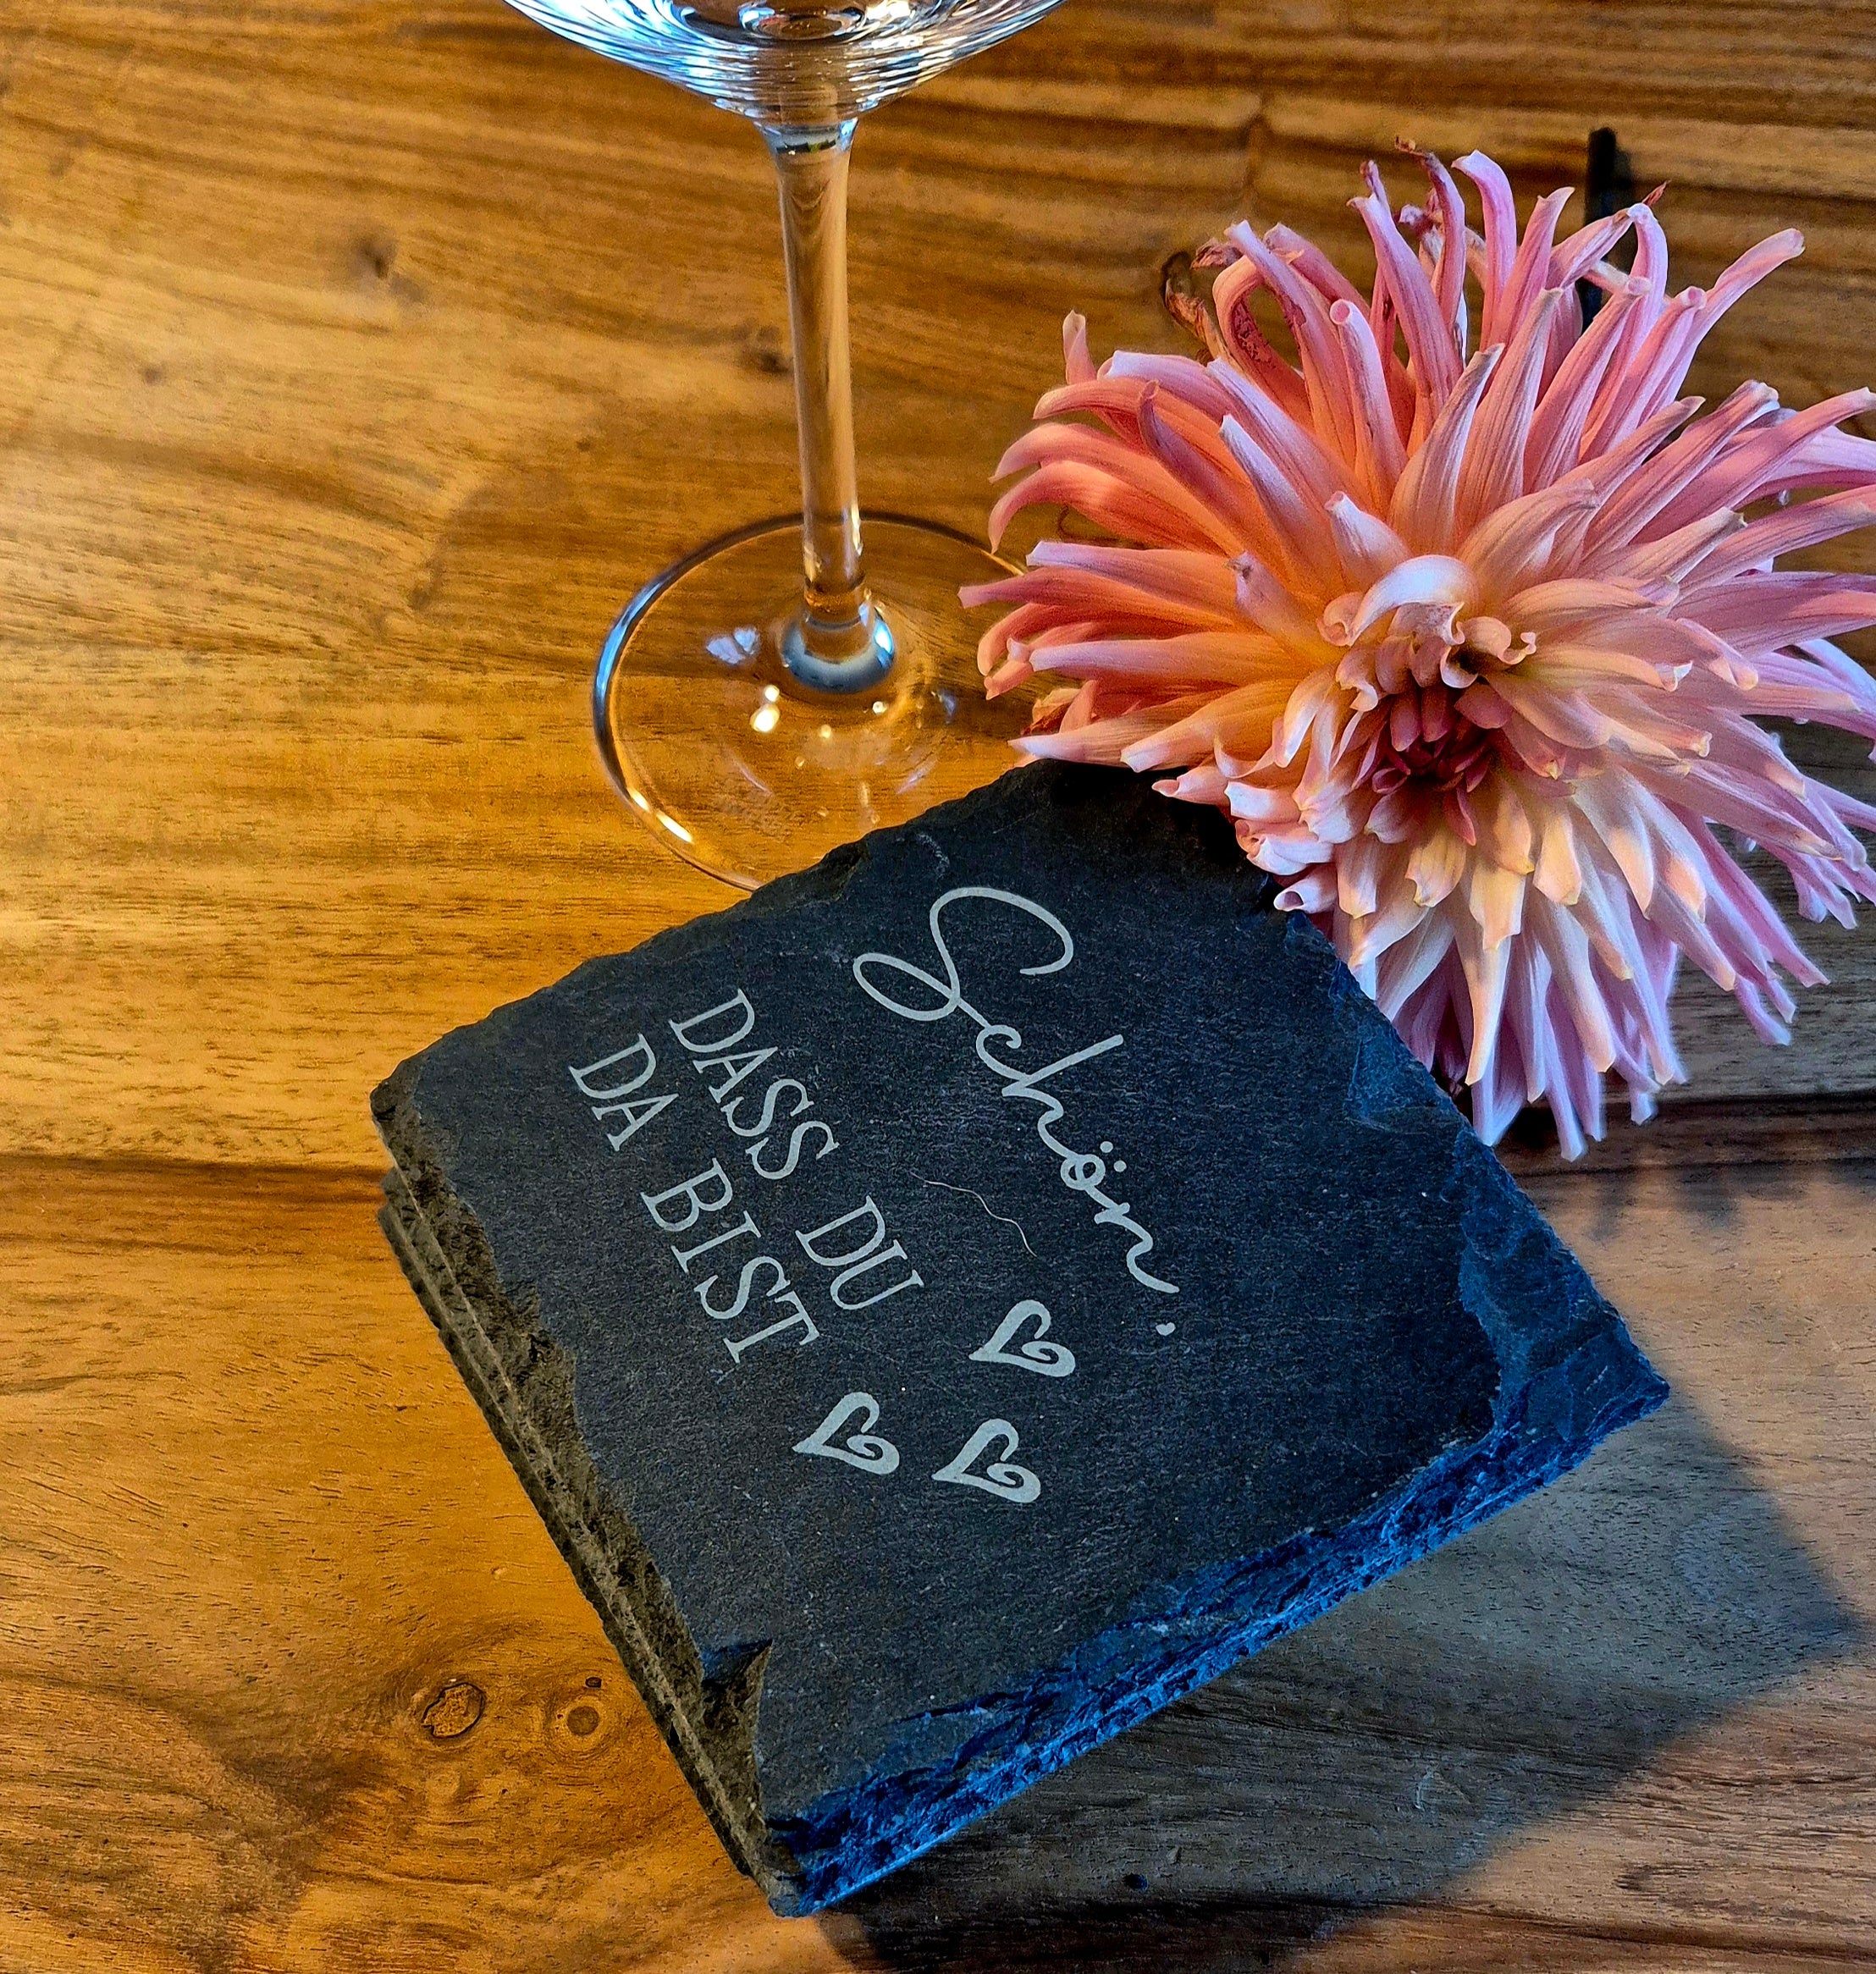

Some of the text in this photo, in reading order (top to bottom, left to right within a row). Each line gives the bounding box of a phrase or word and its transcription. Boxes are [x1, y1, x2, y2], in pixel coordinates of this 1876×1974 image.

[569, 1034, 819, 1363] DA BIST
[669, 989, 924, 1310] DASS DU
